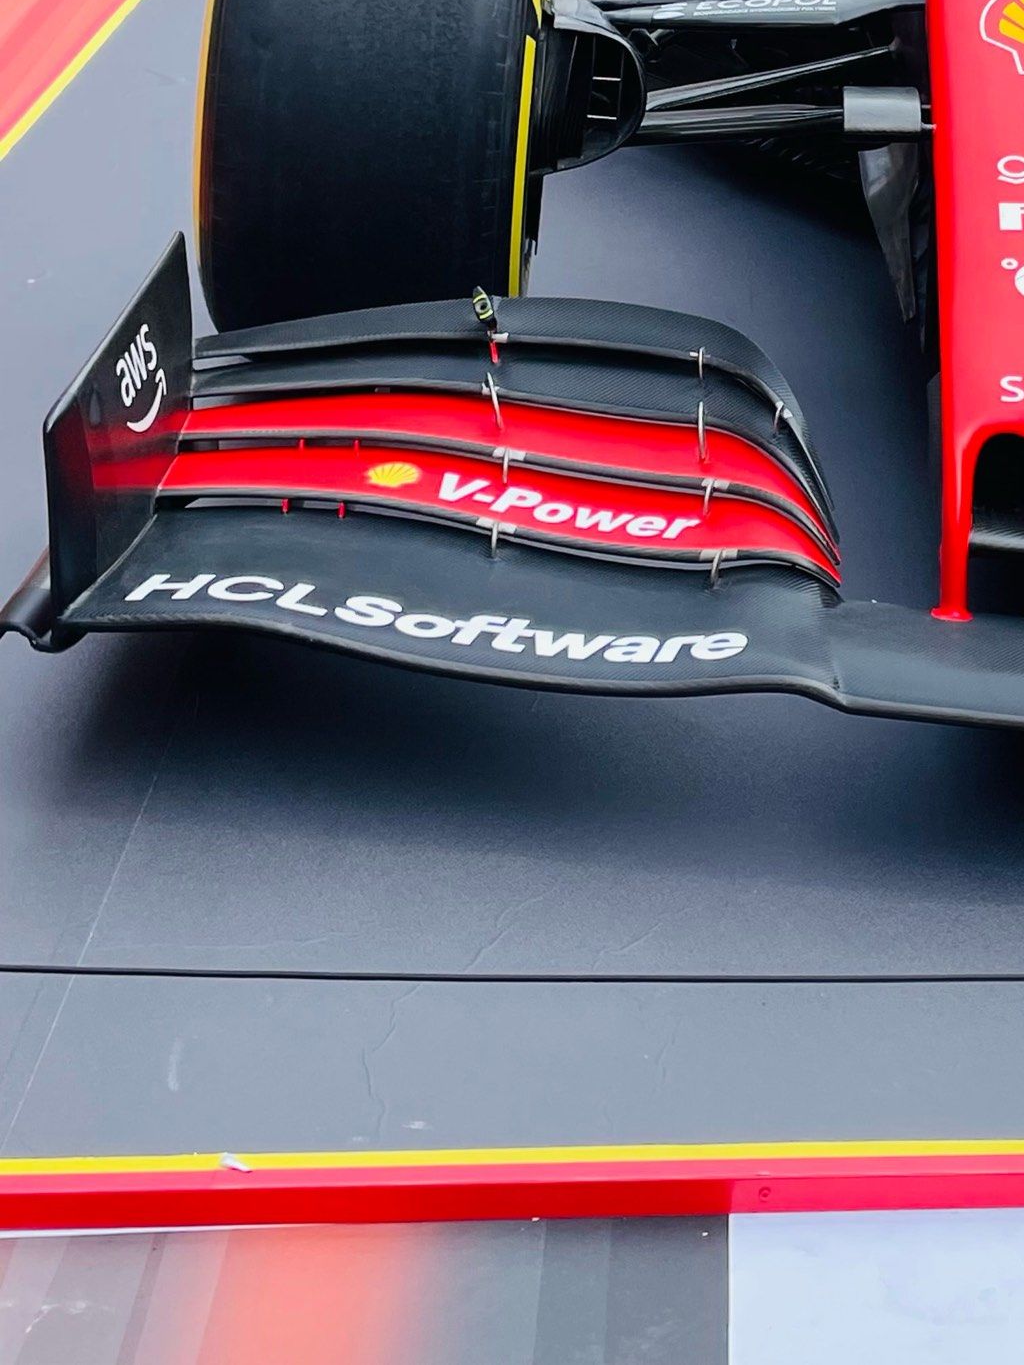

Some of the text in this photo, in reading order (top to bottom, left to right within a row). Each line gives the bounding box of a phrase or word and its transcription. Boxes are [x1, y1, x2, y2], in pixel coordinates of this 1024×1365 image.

[115, 323, 158, 408] aws
[436, 471, 703, 542] V-Power
[124, 573, 750, 664] HCLSoftware
